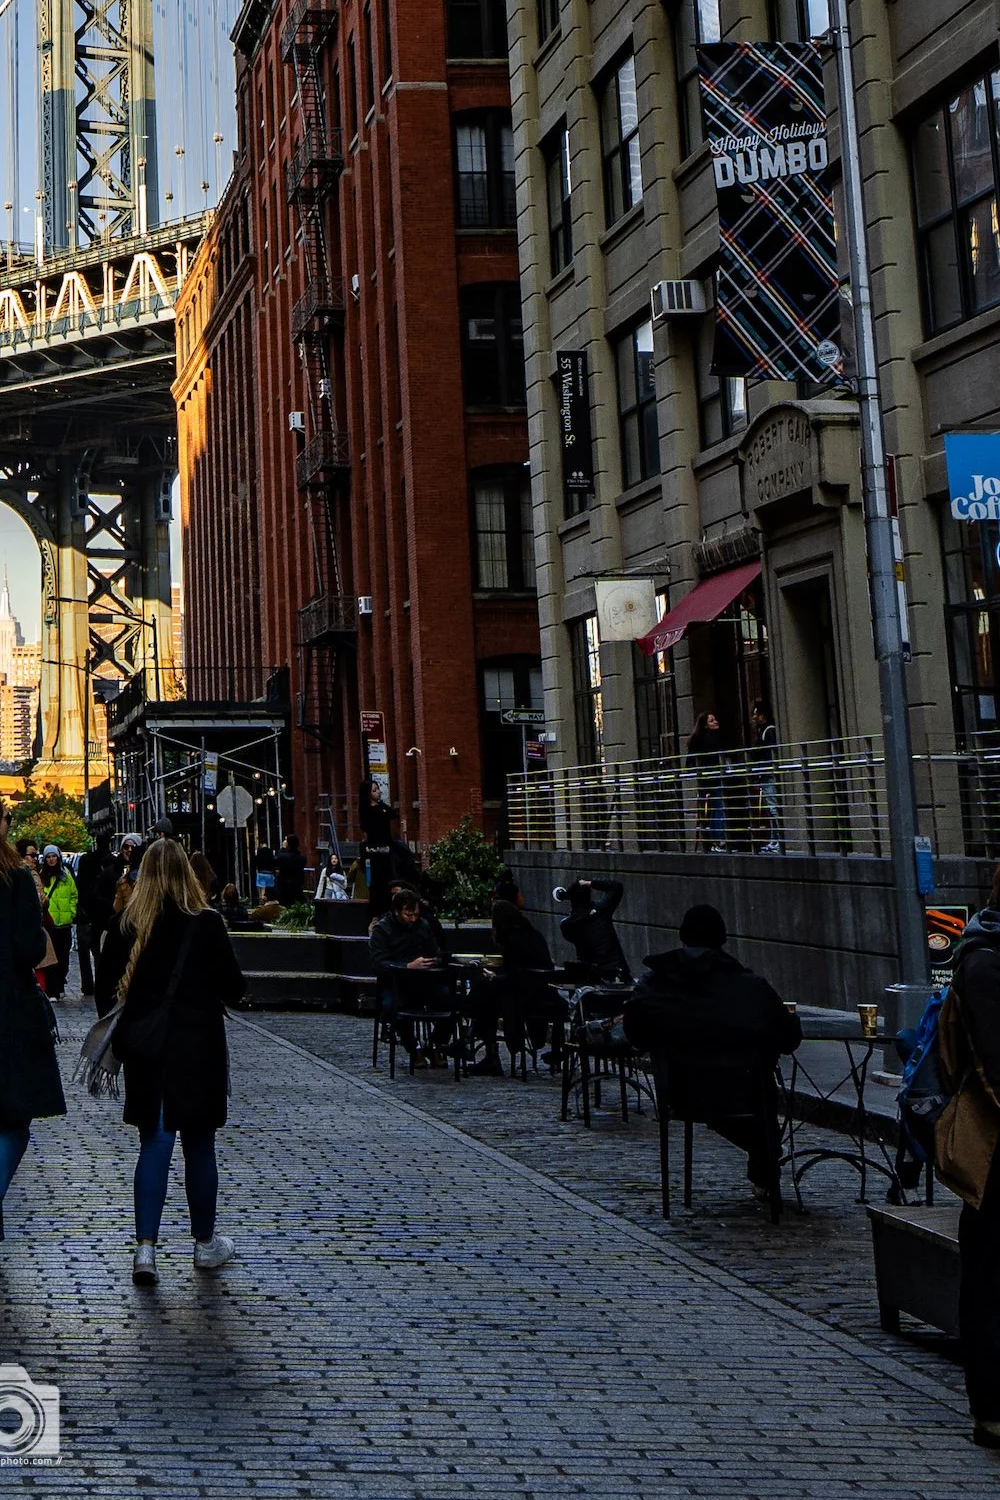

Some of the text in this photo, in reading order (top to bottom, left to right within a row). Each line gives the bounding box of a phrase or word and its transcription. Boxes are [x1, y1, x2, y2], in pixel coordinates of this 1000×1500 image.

[710, 121, 827, 154] Happy Holidays
[713, 138, 828, 188] DUMBO
[560, 357, 576, 448] 55 Washington St.
[748, 418, 811, 475] ROBERT GAIR
[758, 461, 803, 501] COMPANY
